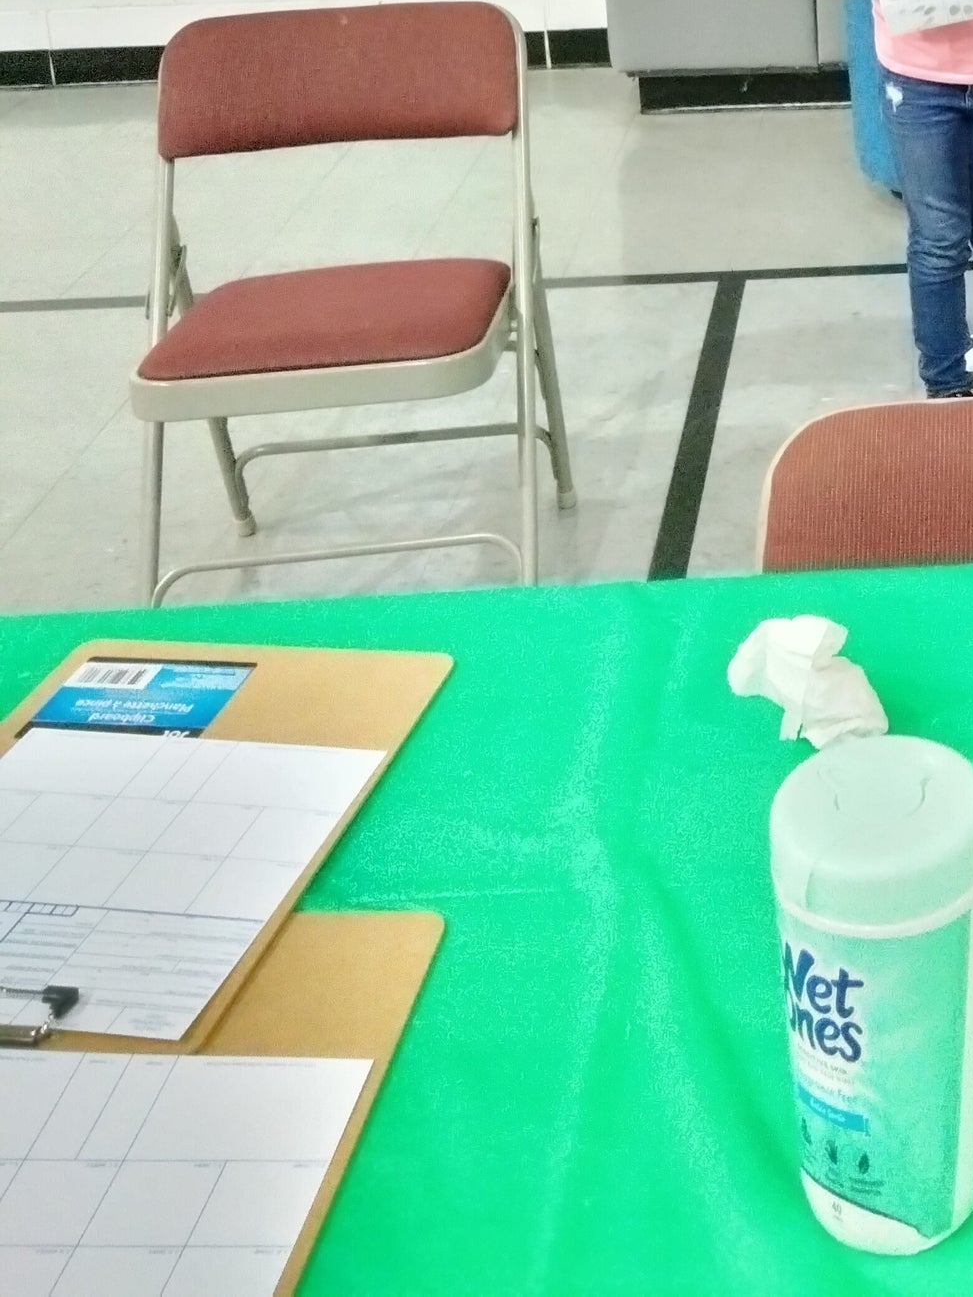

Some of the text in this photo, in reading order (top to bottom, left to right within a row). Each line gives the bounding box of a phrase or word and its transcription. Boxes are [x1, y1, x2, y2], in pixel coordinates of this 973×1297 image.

[75, 699, 110, 710] pince
[125, 702, 194, 714] Planchette
[89, 712, 156, 724] Clipboard
